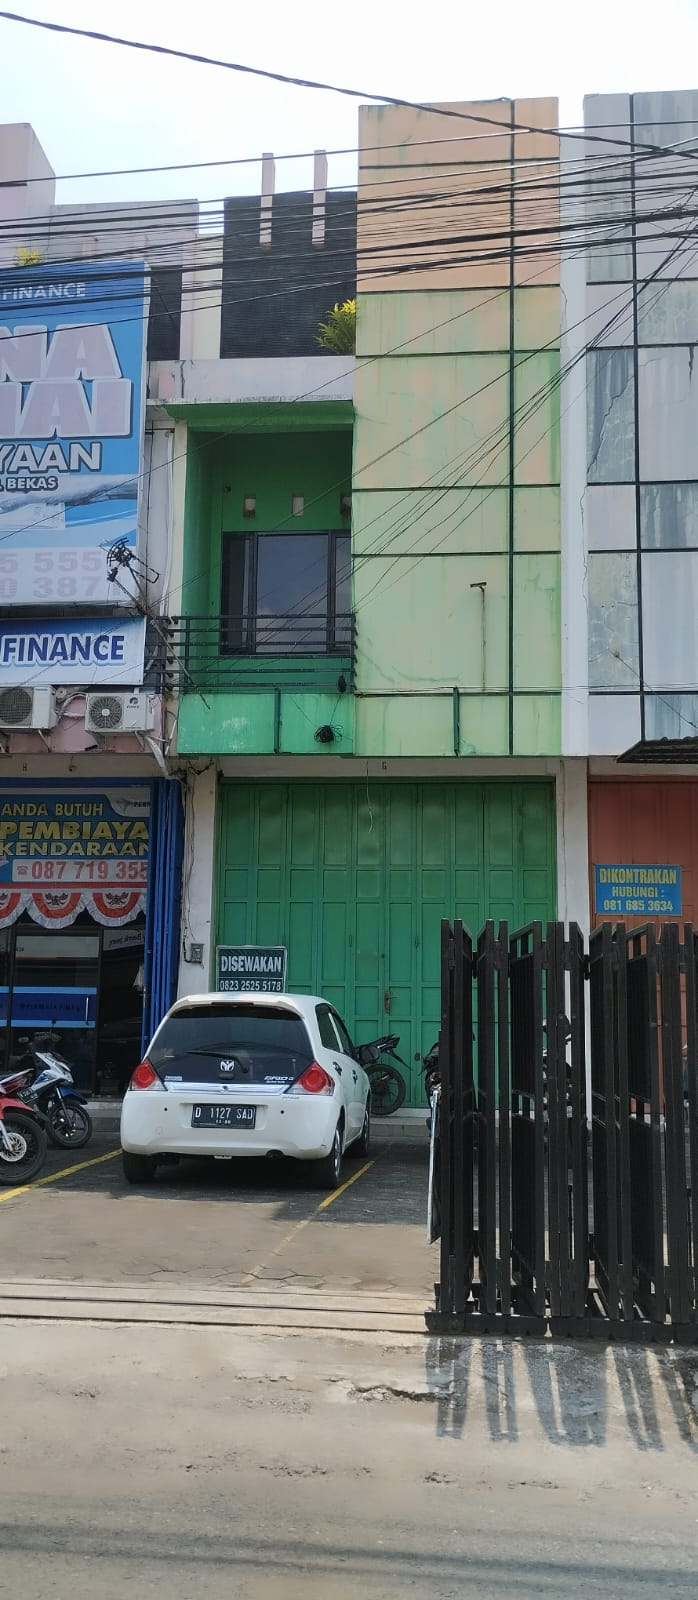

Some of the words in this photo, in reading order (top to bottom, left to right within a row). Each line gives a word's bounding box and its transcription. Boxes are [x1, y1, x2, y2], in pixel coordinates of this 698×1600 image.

[2, 282, 86, 300] FINANCE
[6, 476, 58, 491] BEKAS
[2, 635, 125, 663] FINANCE
[1, 803, 48, 817] ANDA
[55, 803, 103, 816] BUTUH
[0, 821, 149, 840] PEMBIAYA
[31, 861, 67, 880] 087
[73, 861, 109, 880] 719
[599, 868, 677, 884] DIKONTRAKAN
[612, 886, 658, 898] HUBUNGI
[603, 899, 622, 911] 081
[221, 955, 282, 972] DISEWAKAN
[219, 980, 239, 991] 0823
[240, 980, 260, 991] 2525
[262, 981, 281, 991] 5178
[210, 1107, 231, 1119] 1127
